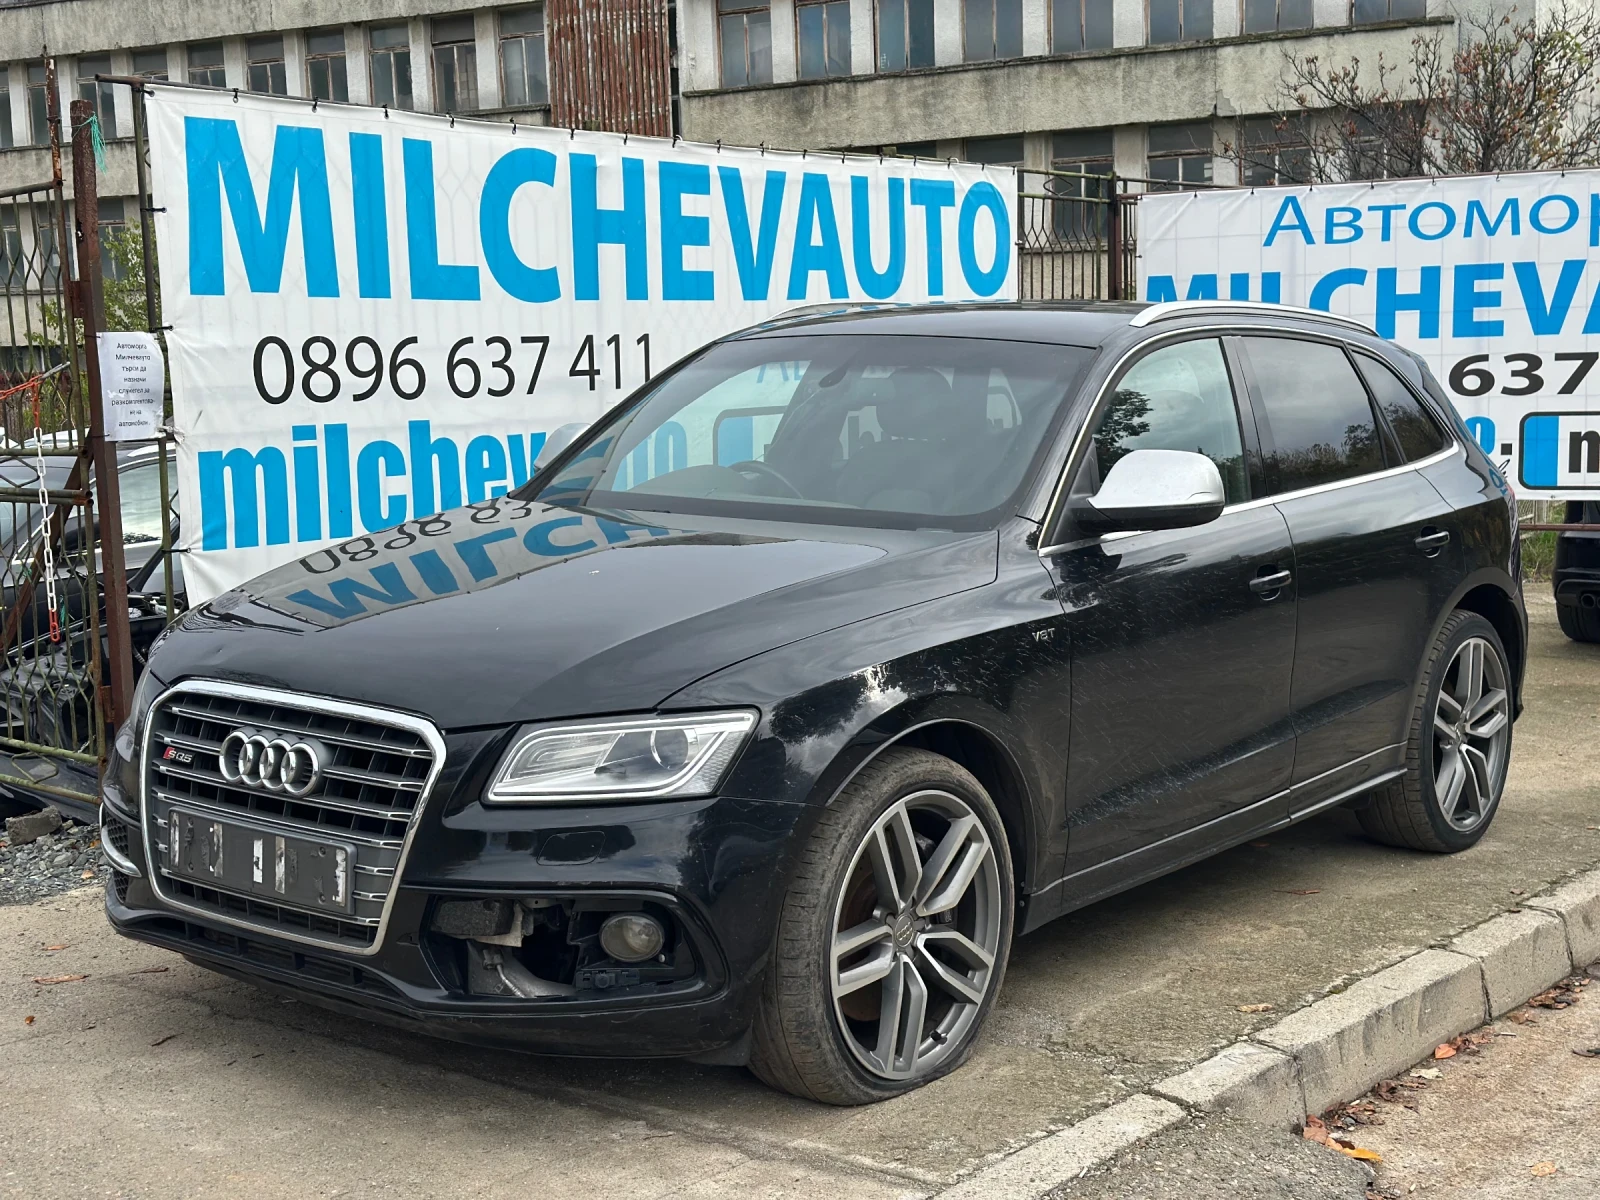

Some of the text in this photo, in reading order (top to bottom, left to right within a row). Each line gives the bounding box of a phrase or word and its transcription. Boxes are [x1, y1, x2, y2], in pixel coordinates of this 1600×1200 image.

[184, 116, 1011, 304] MILCHEVAUTO
[254, 333, 652, 406] 0896 637 411
[1448, 352, 1599, 397] 637
